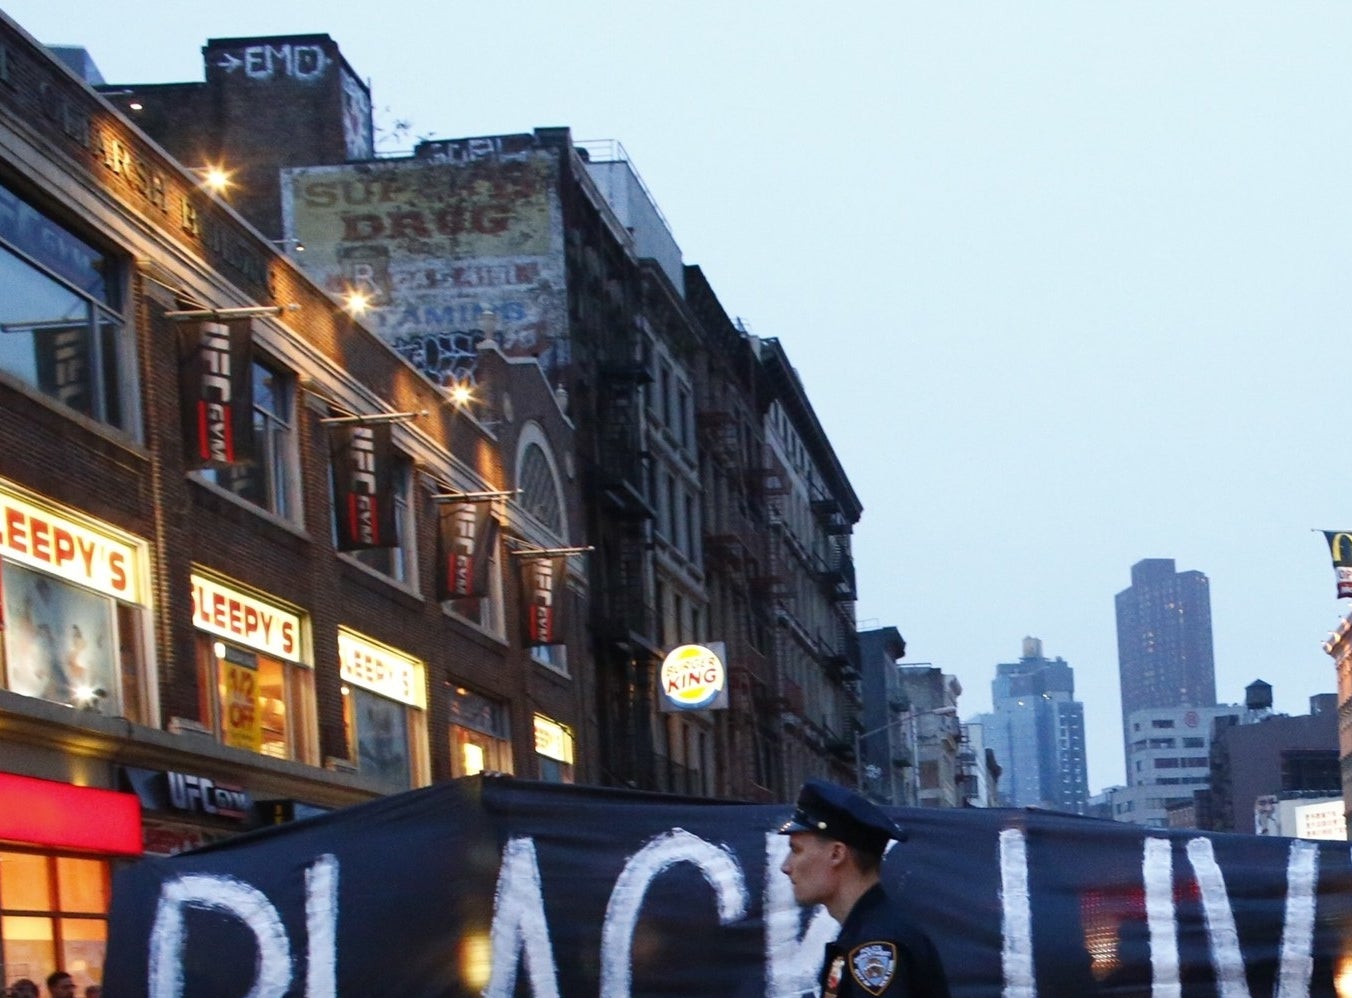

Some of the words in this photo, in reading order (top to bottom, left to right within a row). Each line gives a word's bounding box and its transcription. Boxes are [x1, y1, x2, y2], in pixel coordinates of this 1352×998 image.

[342, 205, 515, 241] DRUG
[668, 668, 717, 693] KING
[167, 771, 218, 815] UFC
